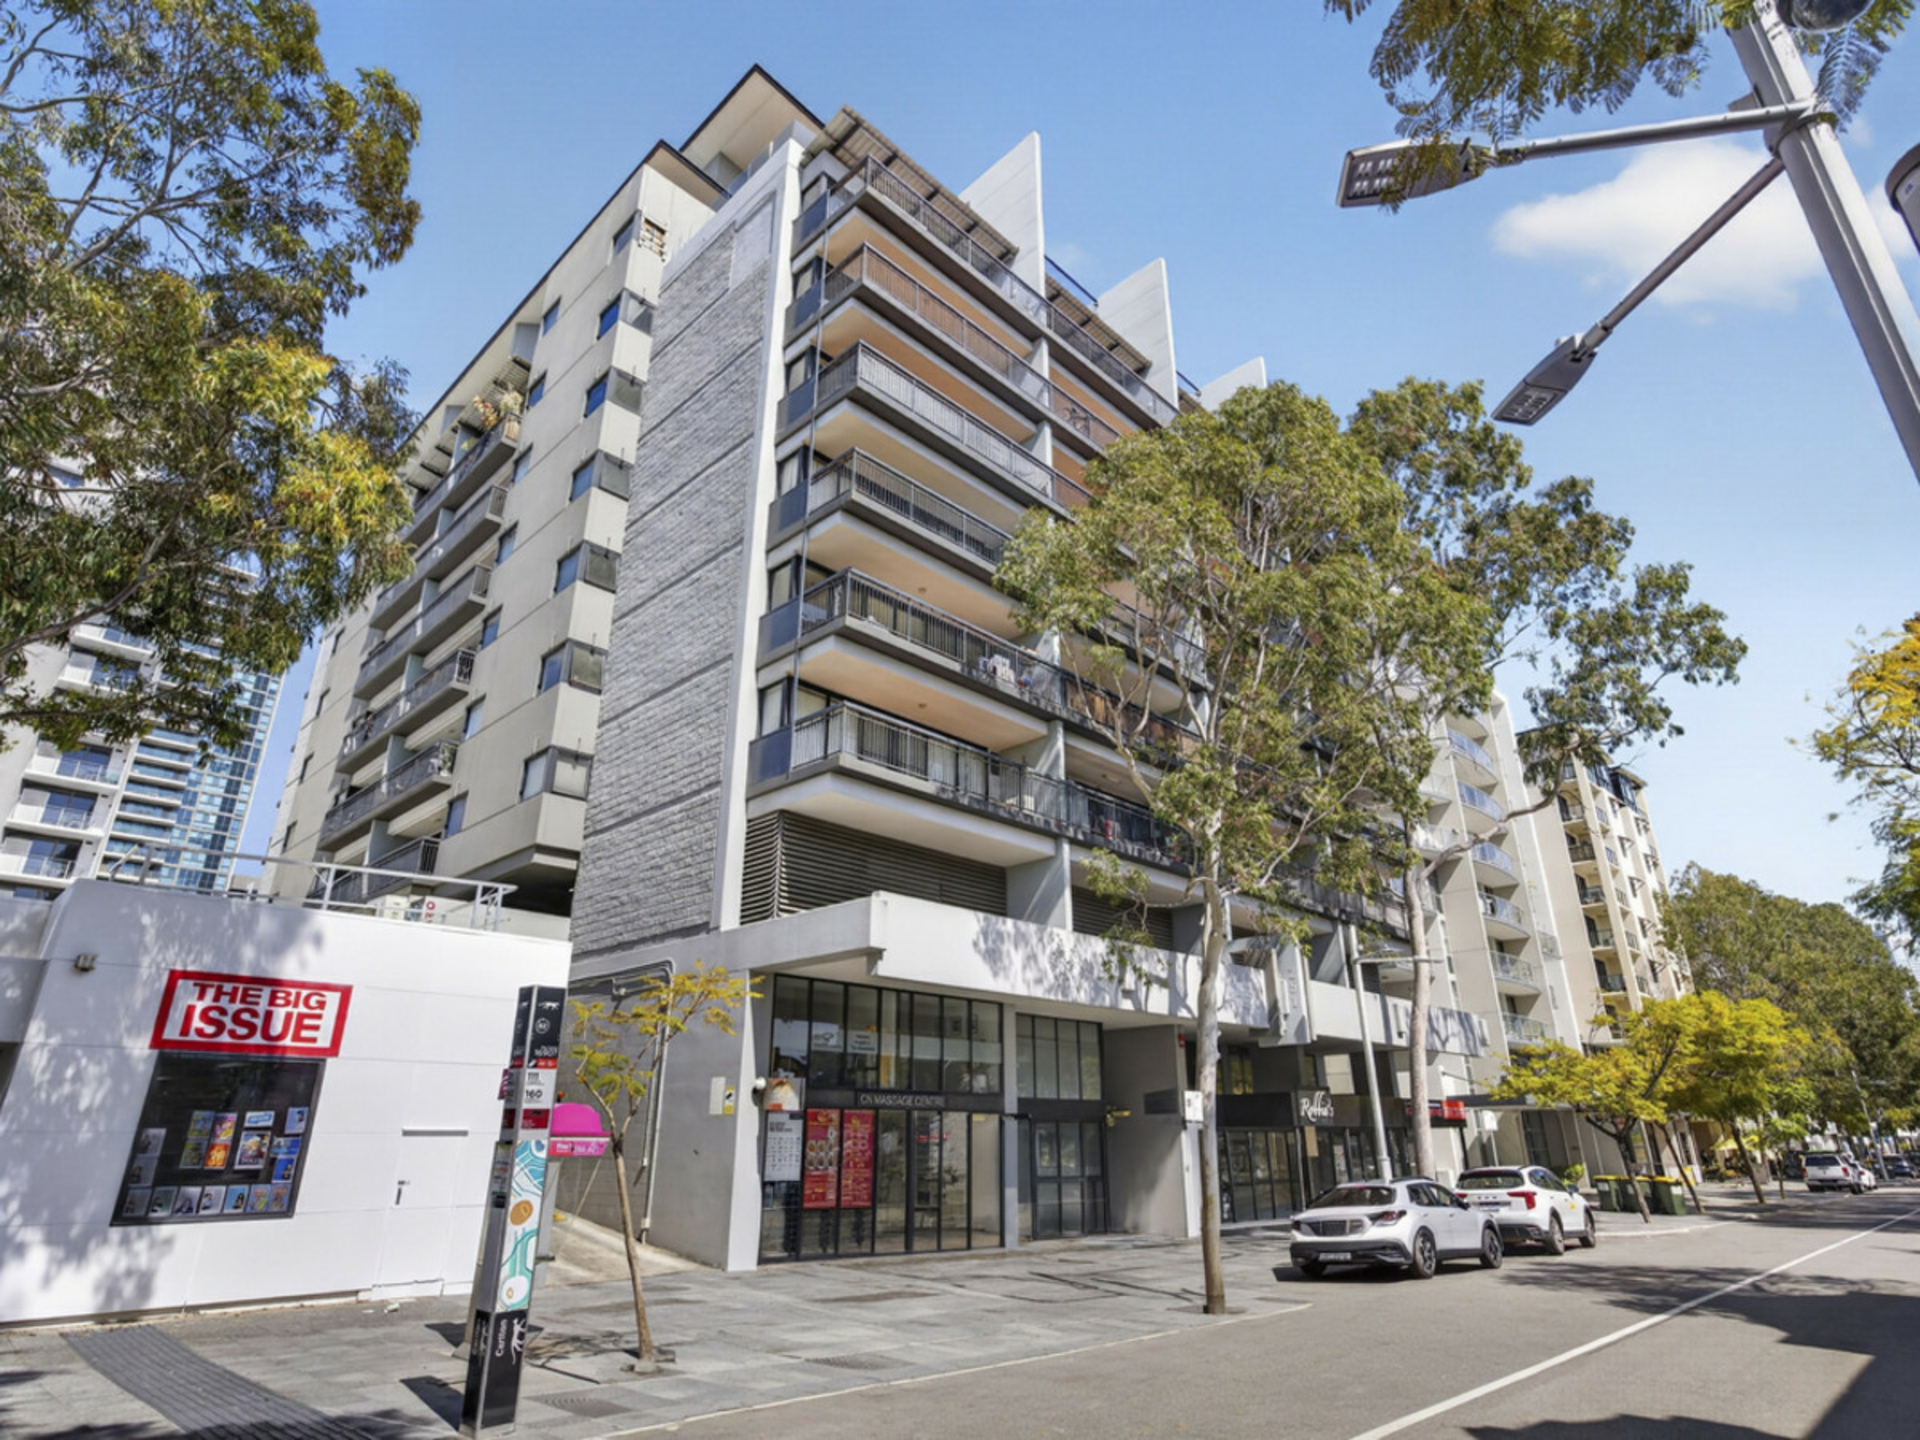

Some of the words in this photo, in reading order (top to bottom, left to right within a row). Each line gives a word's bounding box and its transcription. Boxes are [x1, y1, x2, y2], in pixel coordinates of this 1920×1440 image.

[193, 982, 263, 1006] THE
[268, 990, 326, 1011] BIG
[179, 1004, 323, 1044] ISSUE
[874, 1094, 913, 1106] MASSAGE
